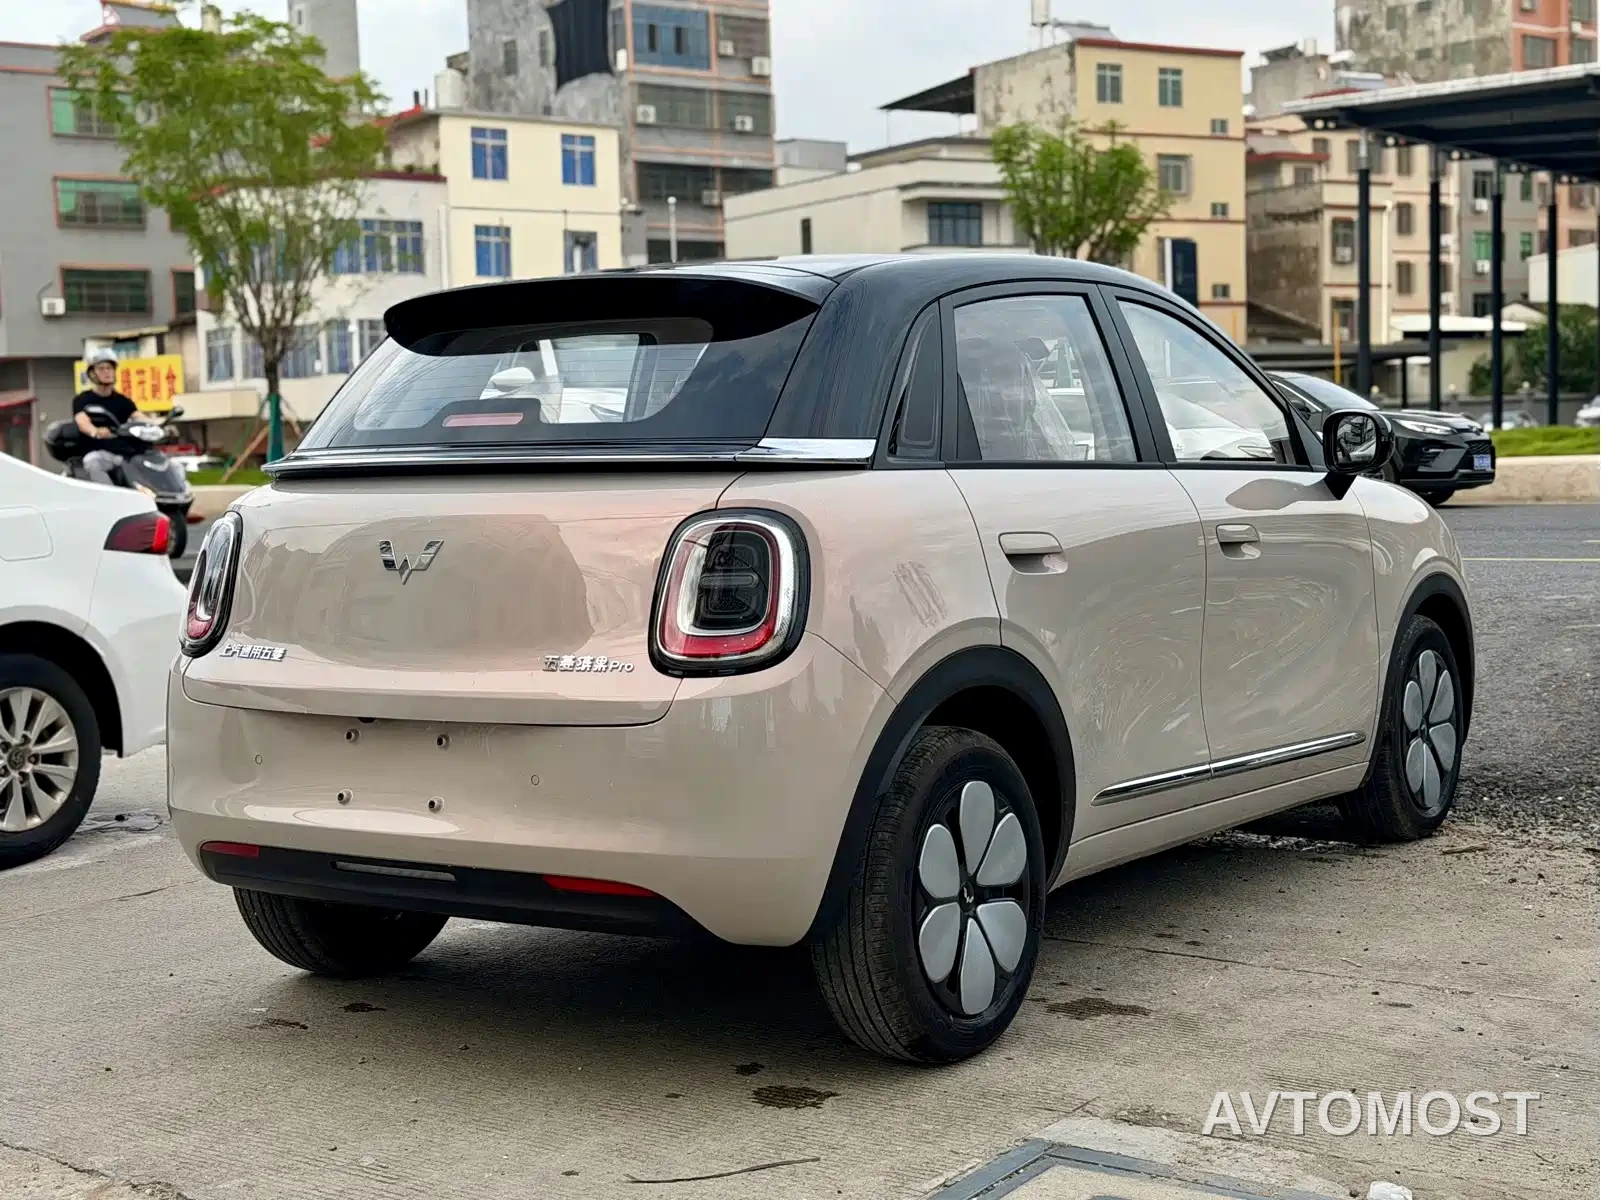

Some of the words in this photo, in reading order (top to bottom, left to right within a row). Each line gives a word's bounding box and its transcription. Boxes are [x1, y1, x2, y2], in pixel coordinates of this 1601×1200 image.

[219, 643, 287, 662] 上汽通用五菱
